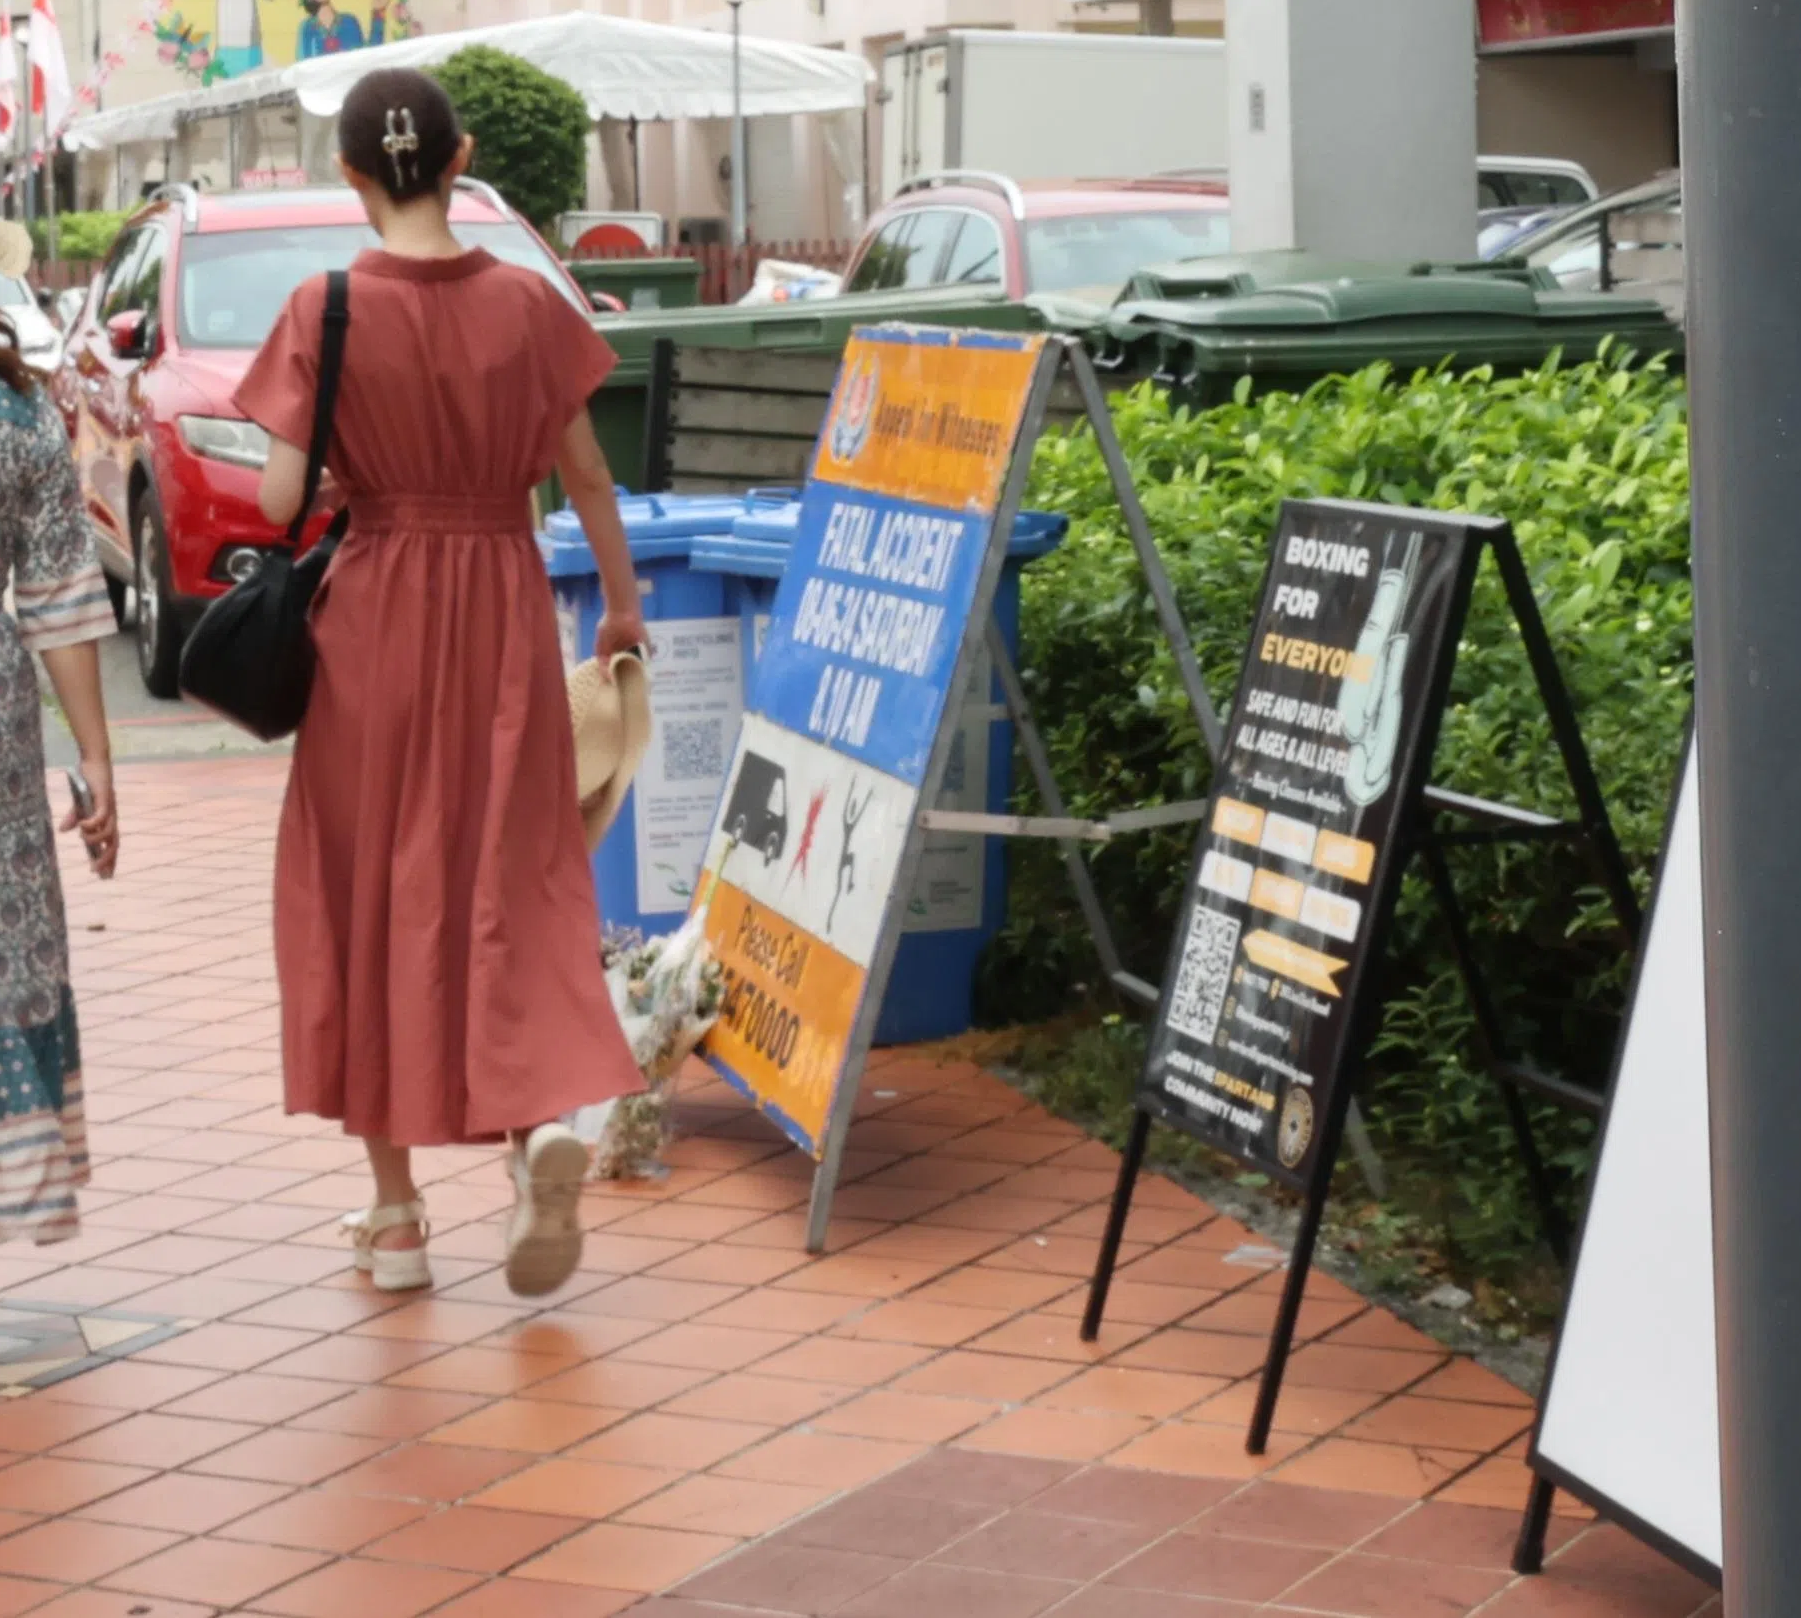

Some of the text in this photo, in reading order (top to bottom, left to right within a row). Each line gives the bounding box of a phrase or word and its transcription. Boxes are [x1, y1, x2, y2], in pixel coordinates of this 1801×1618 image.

[817, 501, 965, 592] FATAL ACCIDENT
[1285, 535, 1370, 577] BOXING
[1273, 584, 1319, 619] FOR
[851, 589, 946, 678] SATURDAY
[837, 670, 883, 749] AM
[1245, 688, 1345, 736] SAFE AND FUN FOR
[1236, 723, 1257, 751] ALL
[1255, 729, 1289, 760] AGES
[1285, 737, 1298, 763] &
[1295, 740, 1318, 768] ALL
